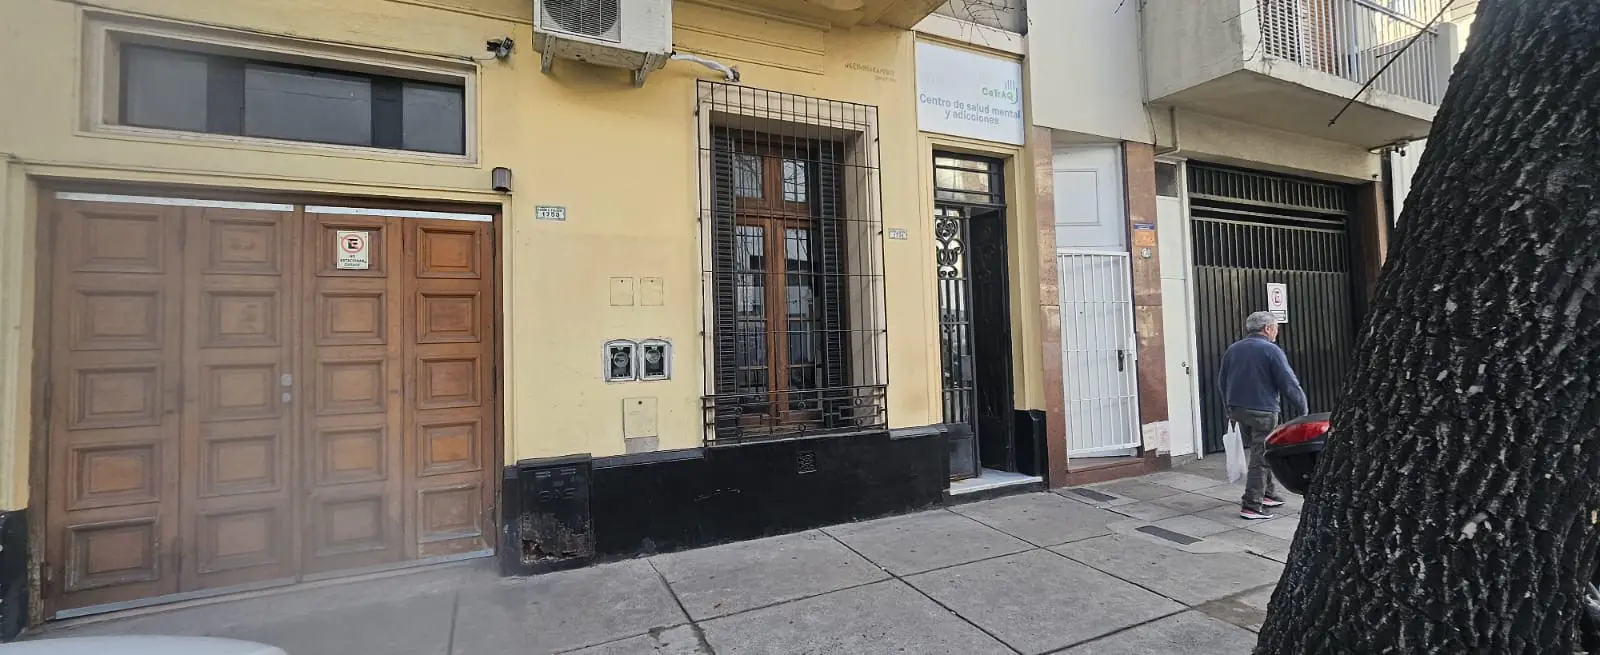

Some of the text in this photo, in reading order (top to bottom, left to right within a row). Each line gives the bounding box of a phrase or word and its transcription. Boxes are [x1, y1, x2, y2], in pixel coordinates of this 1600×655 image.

[920, 93, 1021, 119] Centro de salud mental
[945, 108, 1000, 125] y adicciones
